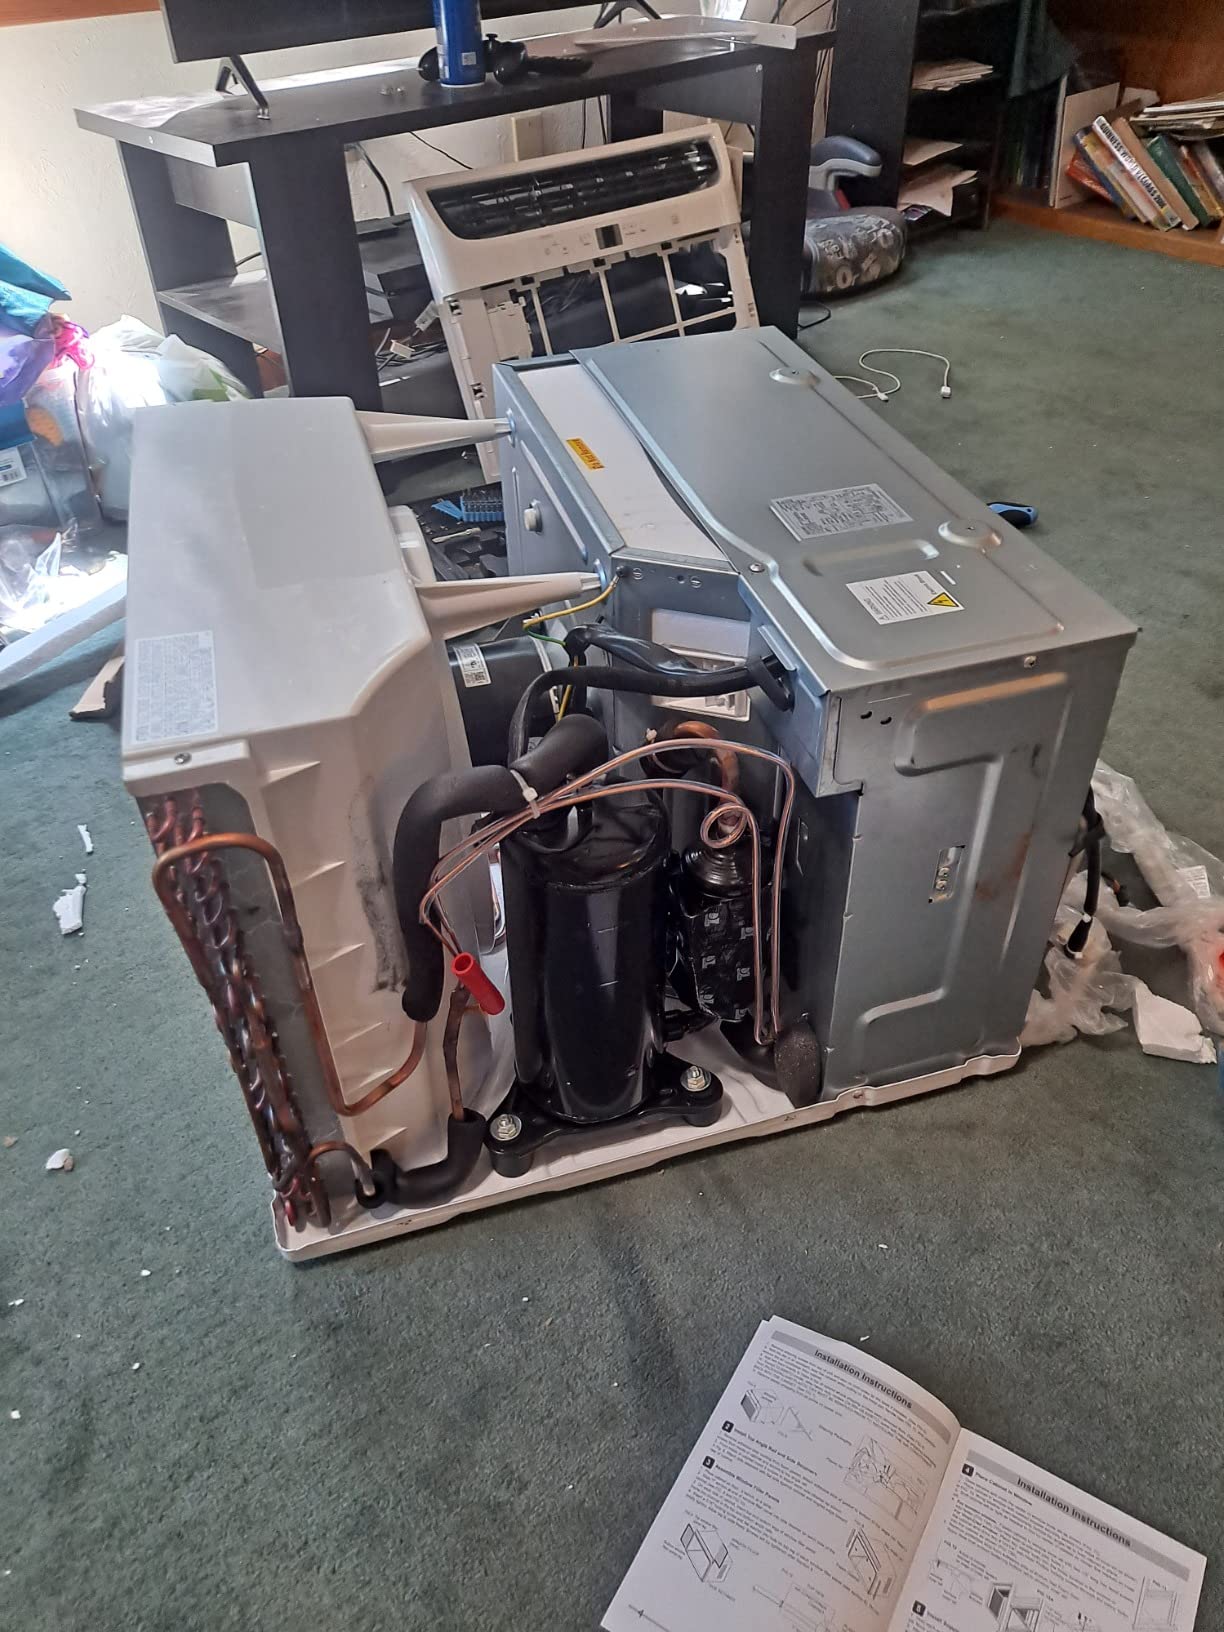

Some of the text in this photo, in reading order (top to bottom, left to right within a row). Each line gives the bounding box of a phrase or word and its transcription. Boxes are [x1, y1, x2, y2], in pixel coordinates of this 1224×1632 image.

[1100, 123, 1124, 152] GUINNESS
[814, 1349, 912, 1409] Installation Instructions
[1017, 1477, 1131, 1548] Installation Instructions
